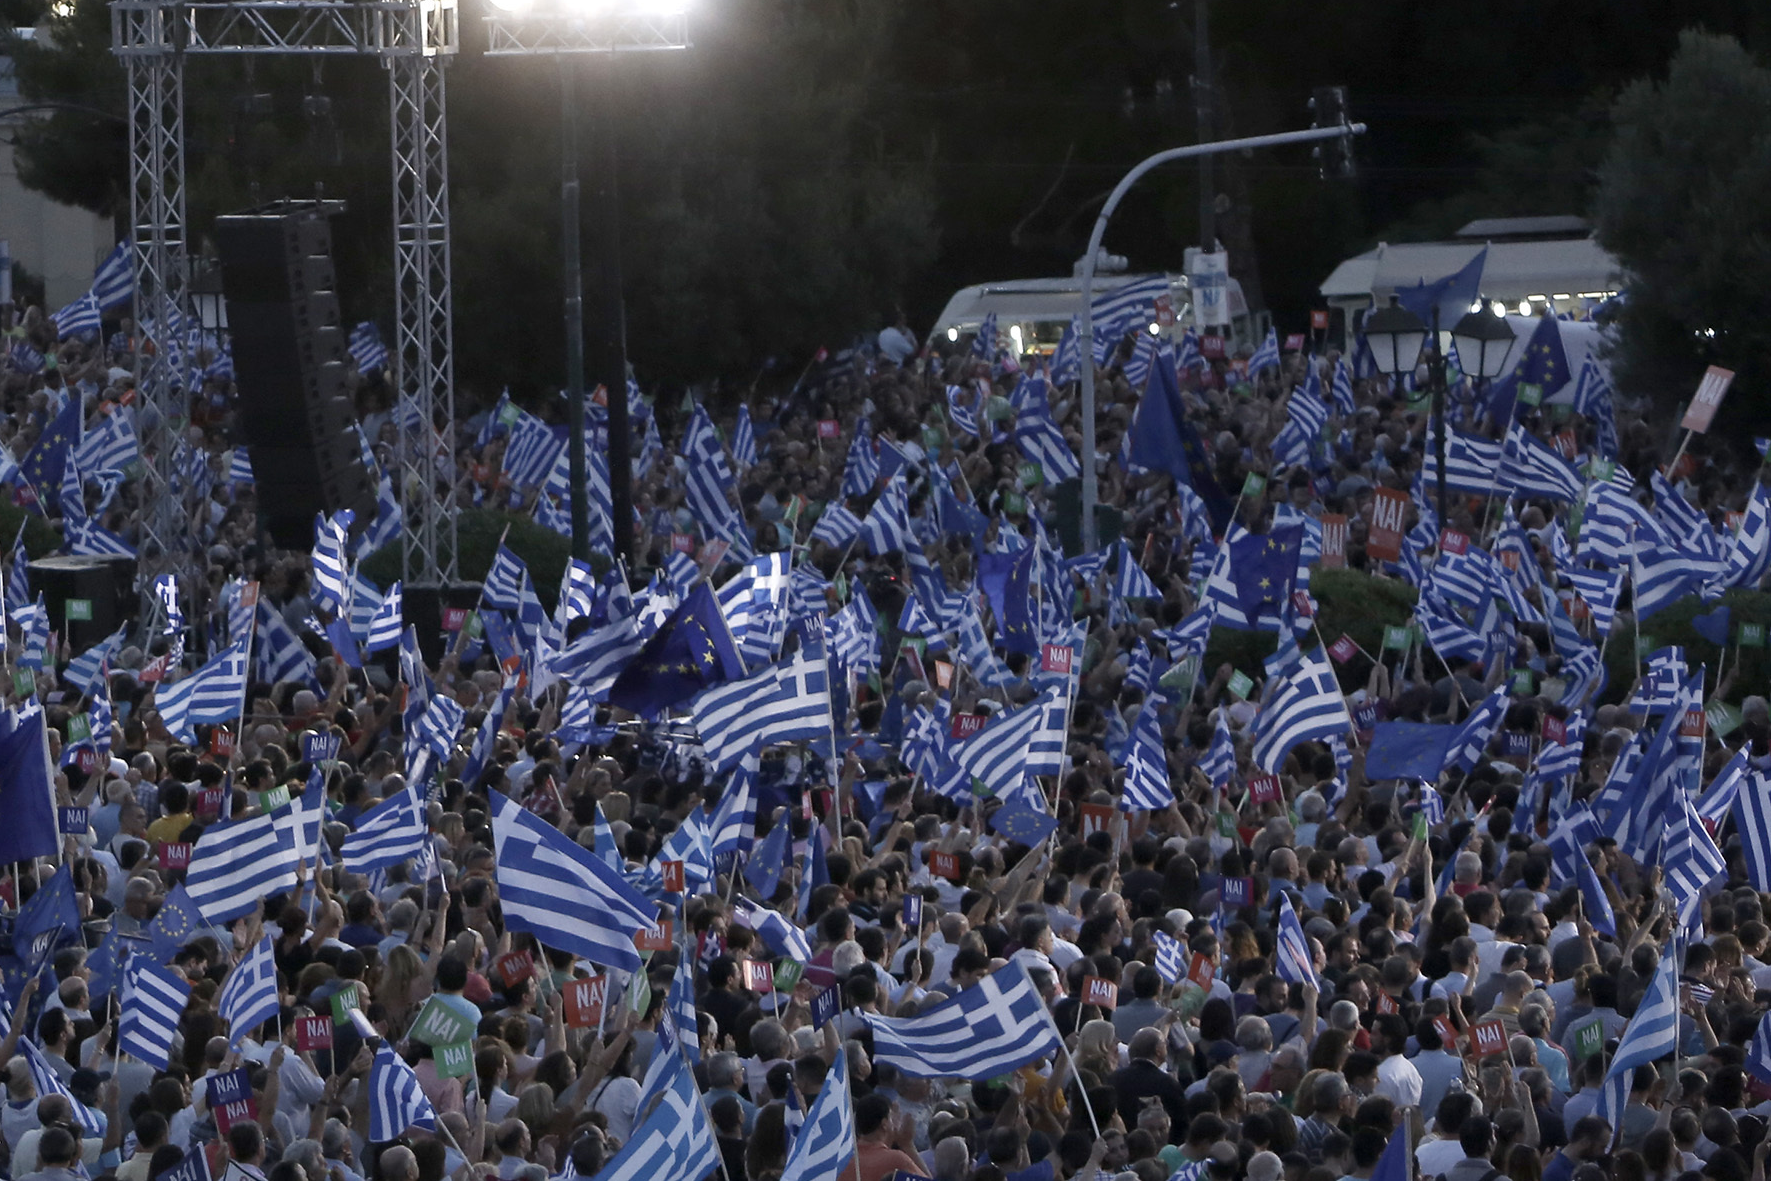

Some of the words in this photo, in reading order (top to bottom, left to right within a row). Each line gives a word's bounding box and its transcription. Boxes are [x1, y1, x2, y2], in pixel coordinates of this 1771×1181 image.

[1695, 372, 1727, 405] ΝΑΙ
[1373, 494, 1404, 532] ΝΑΙ
[1322, 522, 1343, 556] ΝΑΙ
[1446, 532, 1462, 545] ΝΑΙ
[72, 601, 86, 612] ΝΑΙ
[449, 611, 463, 621] ΝΑΙ
[1743, 626, 1759, 636] ΝΑΙ
[1050, 648, 1066, 663] ΝΑΙ
[1359, 707, 1375, 722] ΝΑΙ
[1707, 704, 1728, 729] ΝΑΙ
[70, 717, 83, 730] ΝΑΙ
[961, 718, 980, 731] ΝΑΙ
[1548, 719, 1562, 732] ΝΑΙ
[311, 736, 326, 750] ΝΑΙ
[1510, 735, 1527, 747] ΝΑΙ
[1253, 777, 1272, 793] ΝΑΙ
[204, 791, 221, 804] ΝΑΙ
[268, 790, 283, 805] ΝΑΙ
[67, 810, 85, 823] ΝΑΙ
[167, 845, 185, 858] ΝΑΙ
[936, 855, 952, 869] ΝΑΙ
[1226, 877, 1242, 894] ΝΑΙ
[644, 923, 664, 939] ΝΑΙ
[504, 956, 527, 974] ΝΑΙ
[752, 965, 766, 980] ΝΑΙ
[1089, 979, 1111, 997] ΝΑΙ
[339, 990, 355, 1010] ΝΑΙ
[818, 989, 833, 1013] ΝΑΙ
[307, 1020, 328, 1036] ΝΑΙ
[424, 1007, 460, 1042] ΝΑΙ
[1475, 1026, 1500, 1044] ΝΑΙ
[1582, 1024, 1599, 1045] ΝΑΙ
[444, 1047, 467, 1065] ΝΑΙ
[215, 1074, 238, 1094] ΝΑΙ
[225, 1100, 247, 1118] ΝΑΙ
